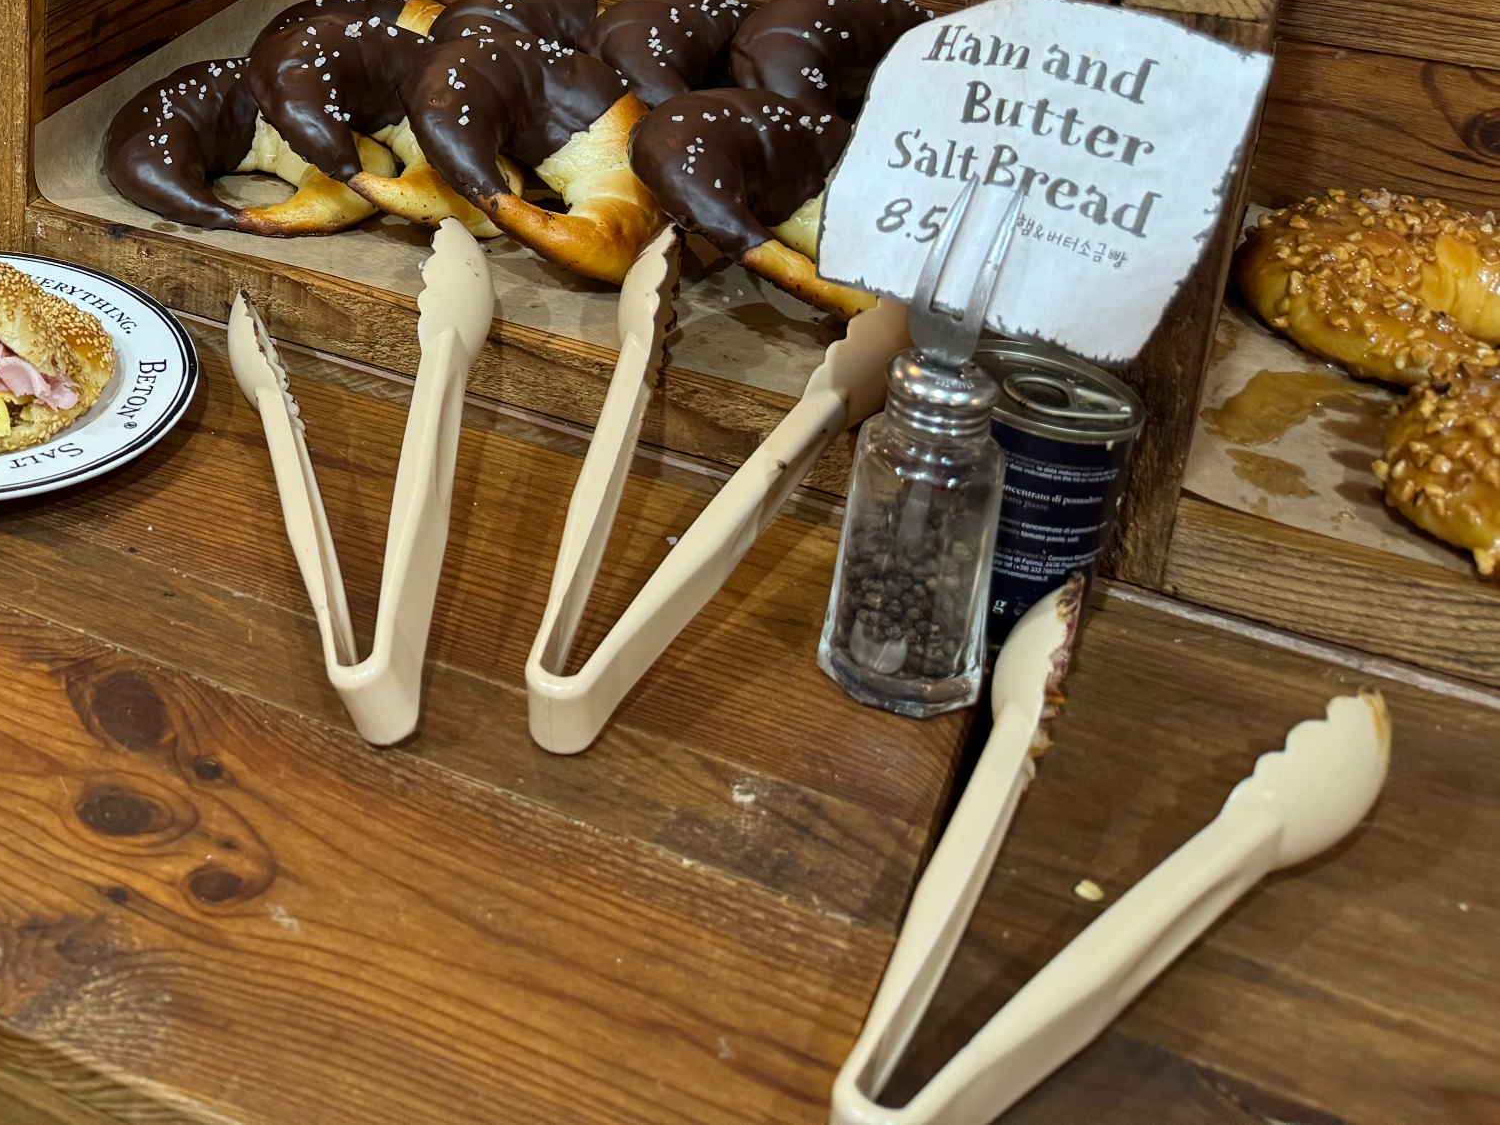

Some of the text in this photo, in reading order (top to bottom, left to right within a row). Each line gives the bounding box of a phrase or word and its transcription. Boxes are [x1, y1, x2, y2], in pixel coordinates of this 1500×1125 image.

[922, 24, 1159, 104] Ham and
[960, 80, 1155, 166] Butter
[876, 197, 948, 243] 8.5
[887, 129, 1163, 238] Salt Bread
[9, 442, 84, 469] SALT
